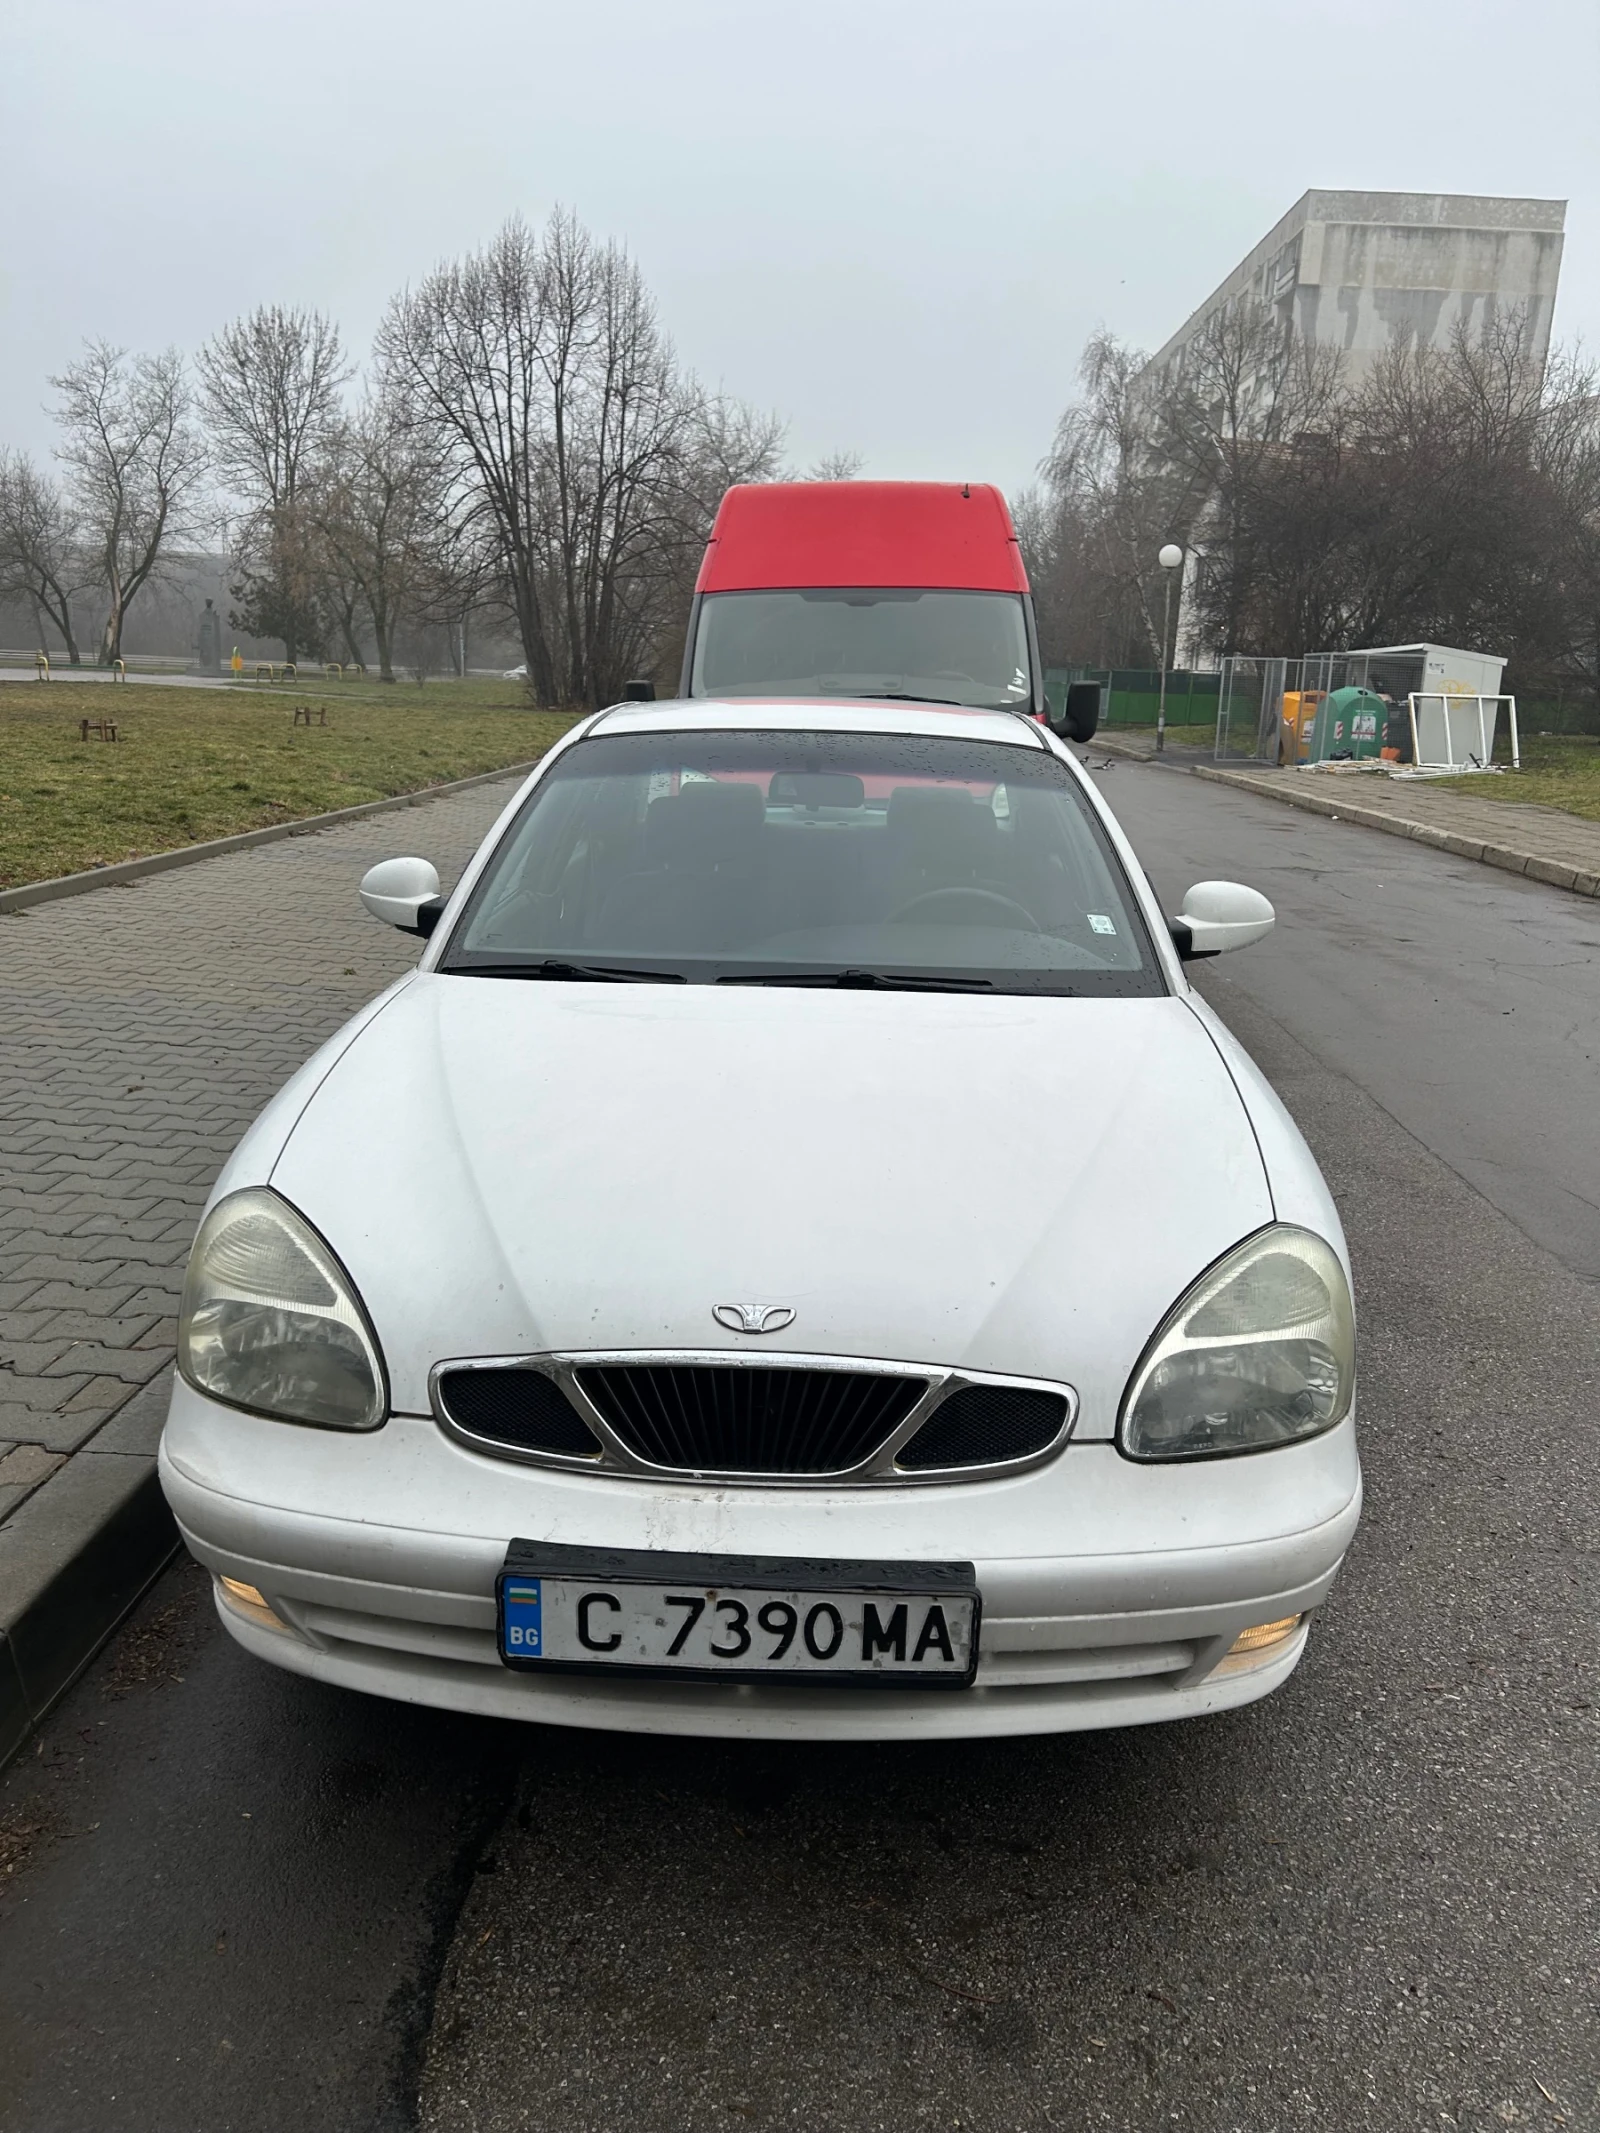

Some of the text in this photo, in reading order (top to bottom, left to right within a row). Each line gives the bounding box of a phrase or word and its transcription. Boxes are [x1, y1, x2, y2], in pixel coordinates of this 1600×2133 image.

[510, 1626, 538, 1646] BG
[577, 1592, 955, 1662] C 7390 MA
